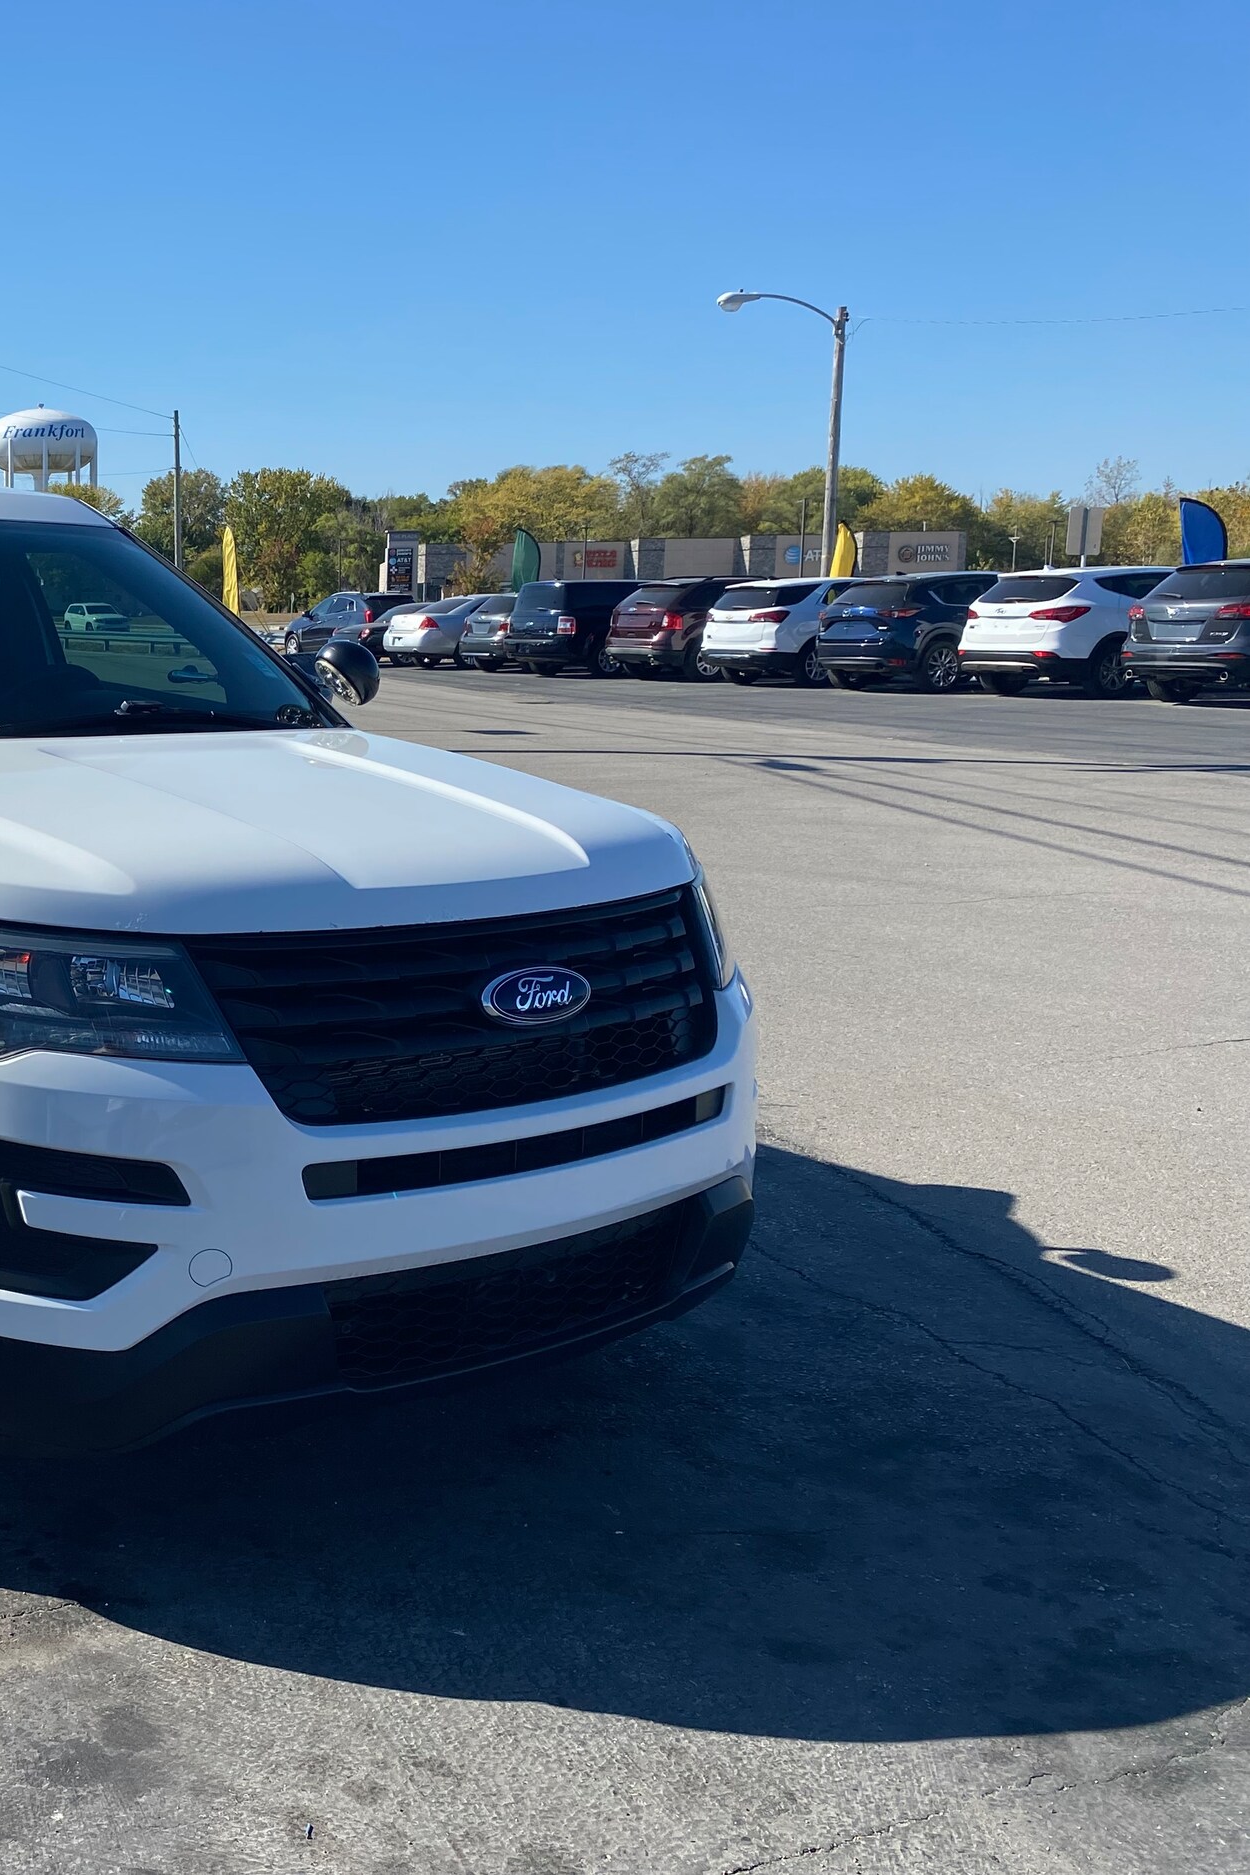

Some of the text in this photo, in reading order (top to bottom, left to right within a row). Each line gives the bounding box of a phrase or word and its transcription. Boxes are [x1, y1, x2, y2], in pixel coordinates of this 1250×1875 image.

[3, 424, 85, 441] Frankfort
[916, 545, 950, 554] JIMMY
[916, 554, 950, 563] JOHN'S
[516, 975, 573, 1012] Ford
